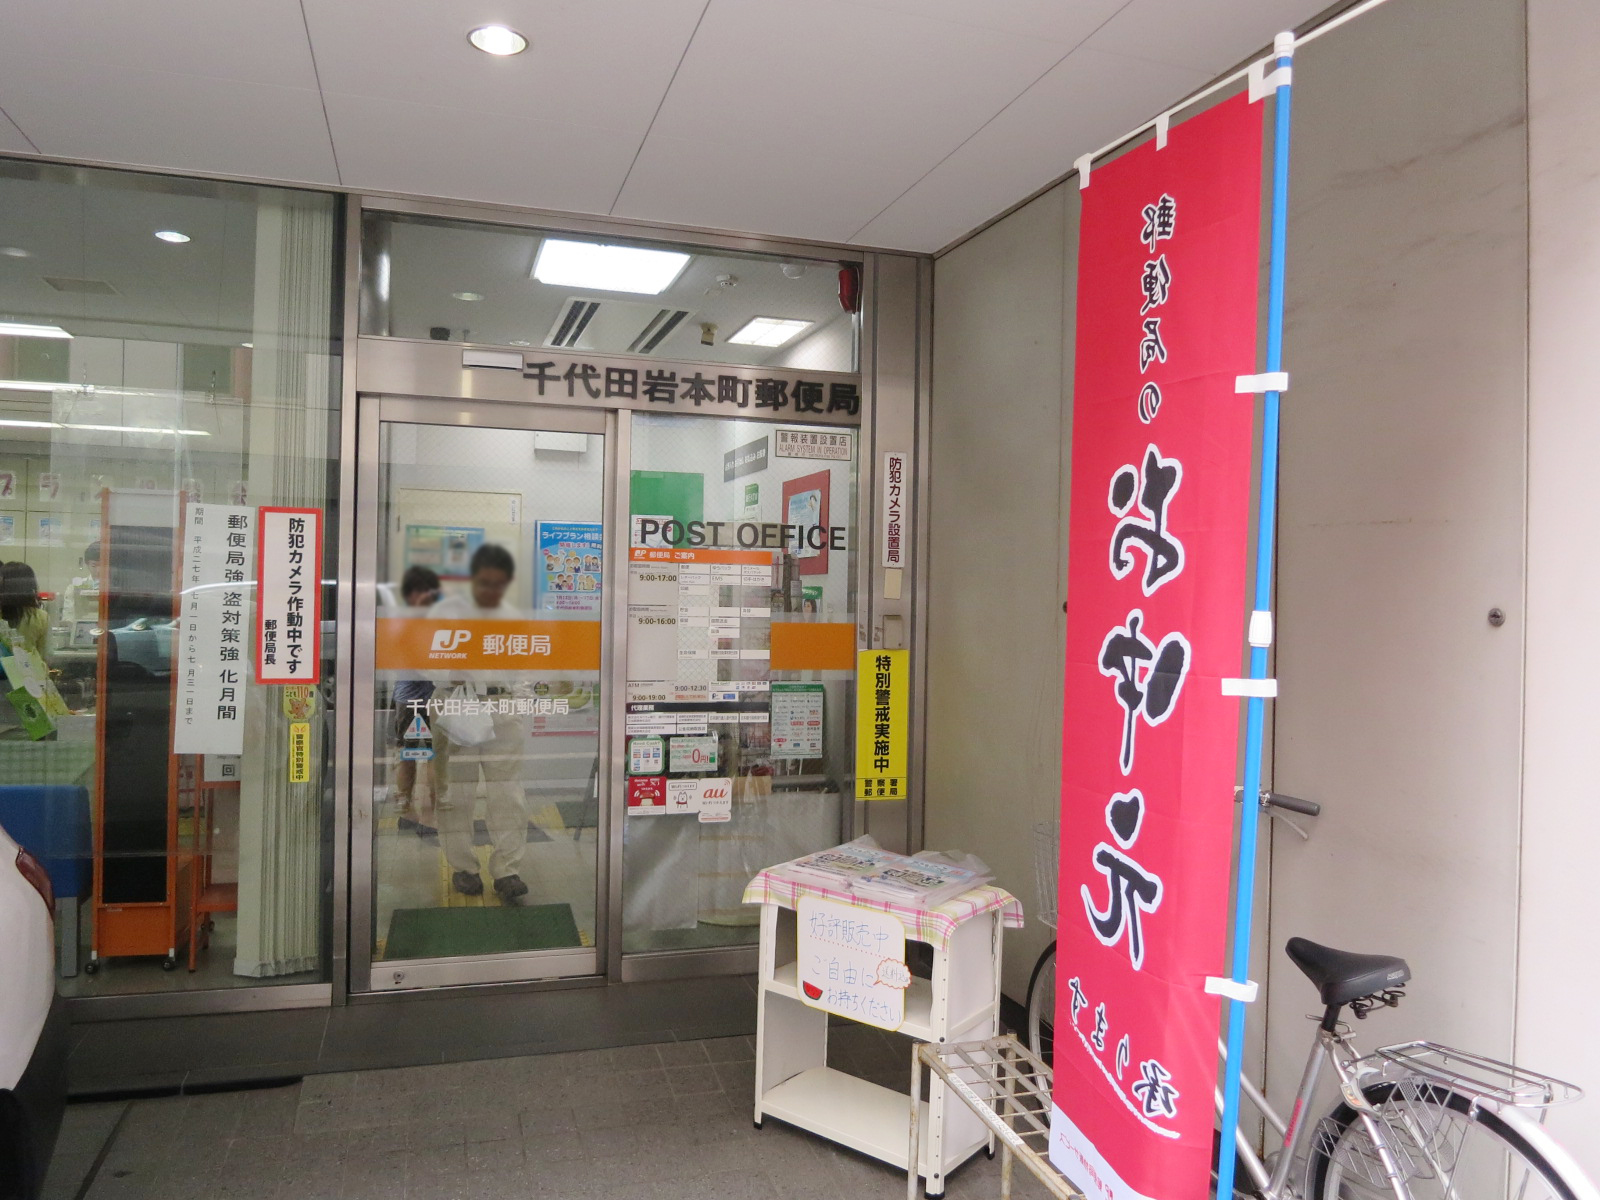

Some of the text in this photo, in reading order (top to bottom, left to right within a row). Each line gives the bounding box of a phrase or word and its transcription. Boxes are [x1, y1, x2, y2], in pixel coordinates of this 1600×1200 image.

[522, 361, 860, 415] 千代田岩本町郵便局
[779, 444, 795, 452] ALARM
[797, 445, 816, 454] SYSTEM
[817, 446, 822, 454] IN
[823, 446, 848, 456] OPERATION
[780, 432, 847, 446] 警報装置設置店
[194, 507, 204, 526] 期間
[887, 457, 902, 563] 防犯カメラ設置局
[640, 519, 846, 550] POST OFFICE
[640, 574, 677, 582] 9:00-17:00
[287, 517, 305, 674] 防犯カメラ作動中です
[217, 514, 248, 720] 郵便局強盗対策強化月間
[264, 619, 277, 665] 郵便局長
[431, 629, 552, 656] JP 郵便局
[406, 698, 570, 716] 千代田岩本町郵便局
[874, 655, 892, 773] 特別警戒実施中
[703, 788, 728, 799] au
[864, 788, 898, 797] 郵便局
[809, 910, 889, 952] 好評販売中
[812, 956, 874, 988] ご自由に
[827, 987, 902, 1022] お持ちください
